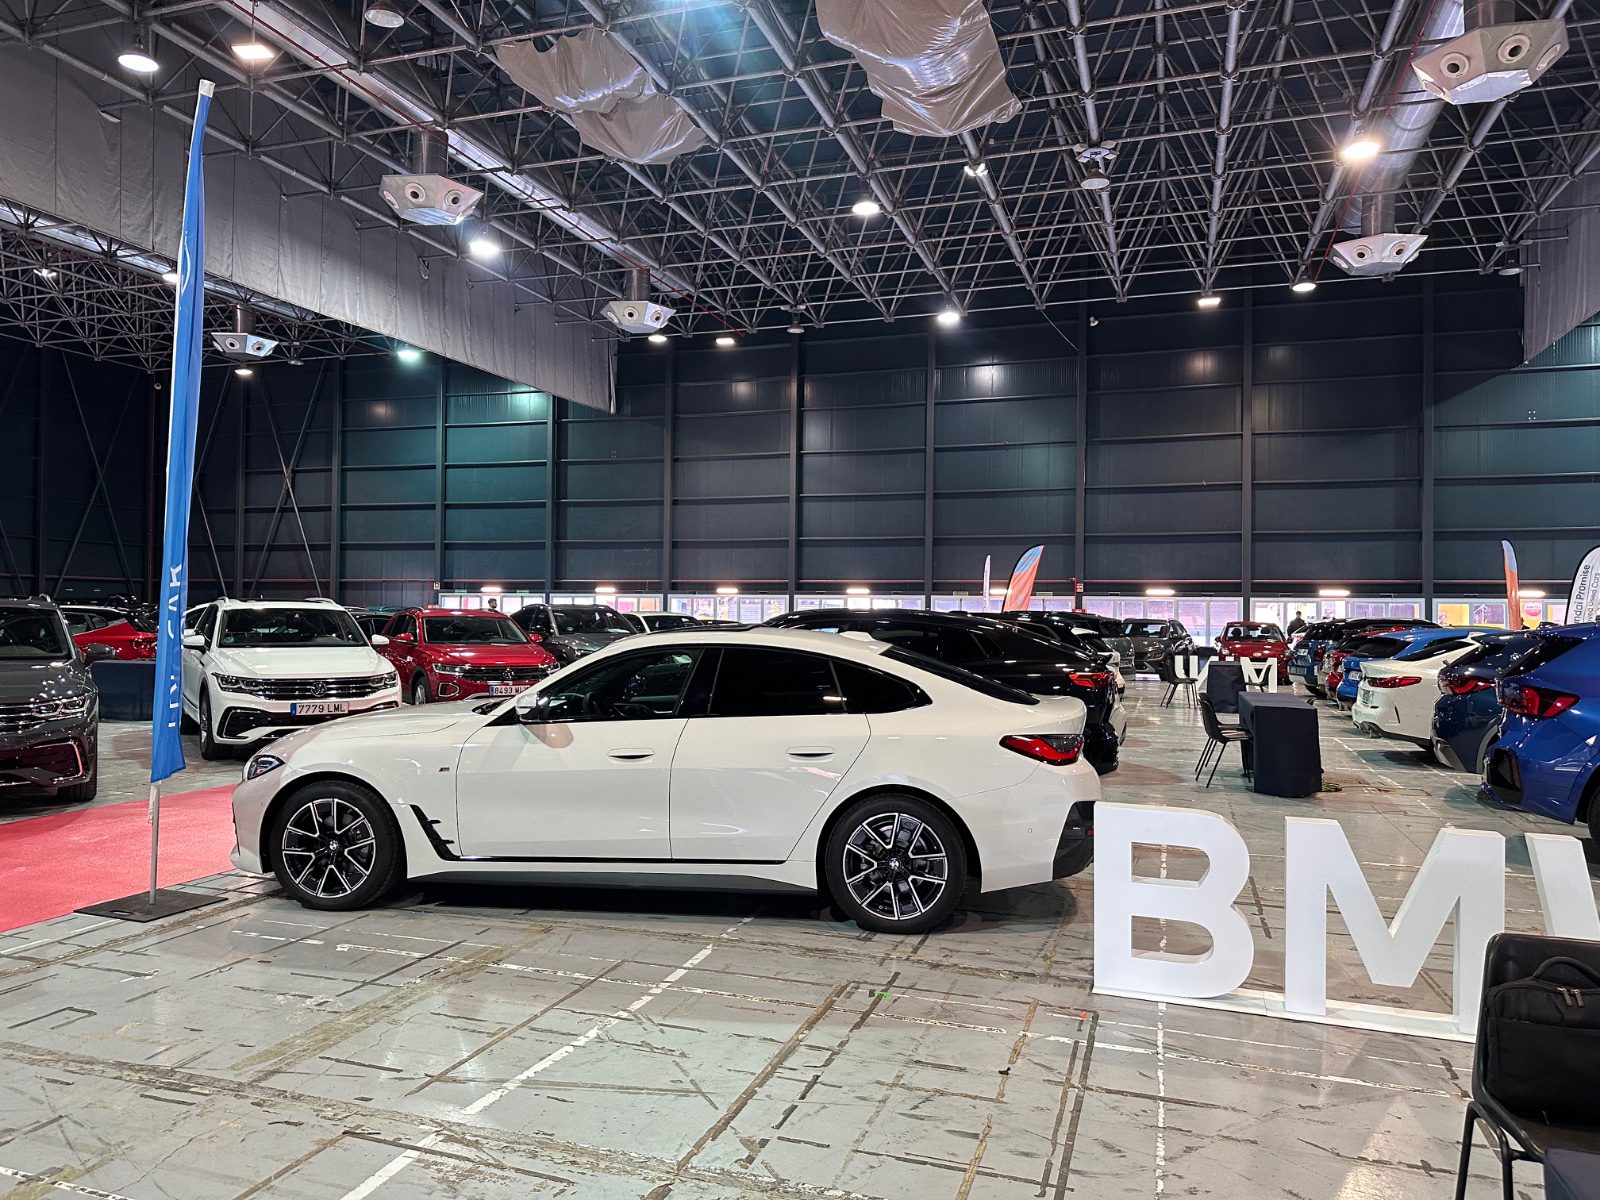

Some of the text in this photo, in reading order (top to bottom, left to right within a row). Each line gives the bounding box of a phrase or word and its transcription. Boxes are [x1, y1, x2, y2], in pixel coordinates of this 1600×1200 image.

[1575, 564, 1591, 601] Promise
[1591, 572, 1600, 589] Cars
[494, 686, 513, 694] 8493
[298, 703, 346, 714] 7779 LML
